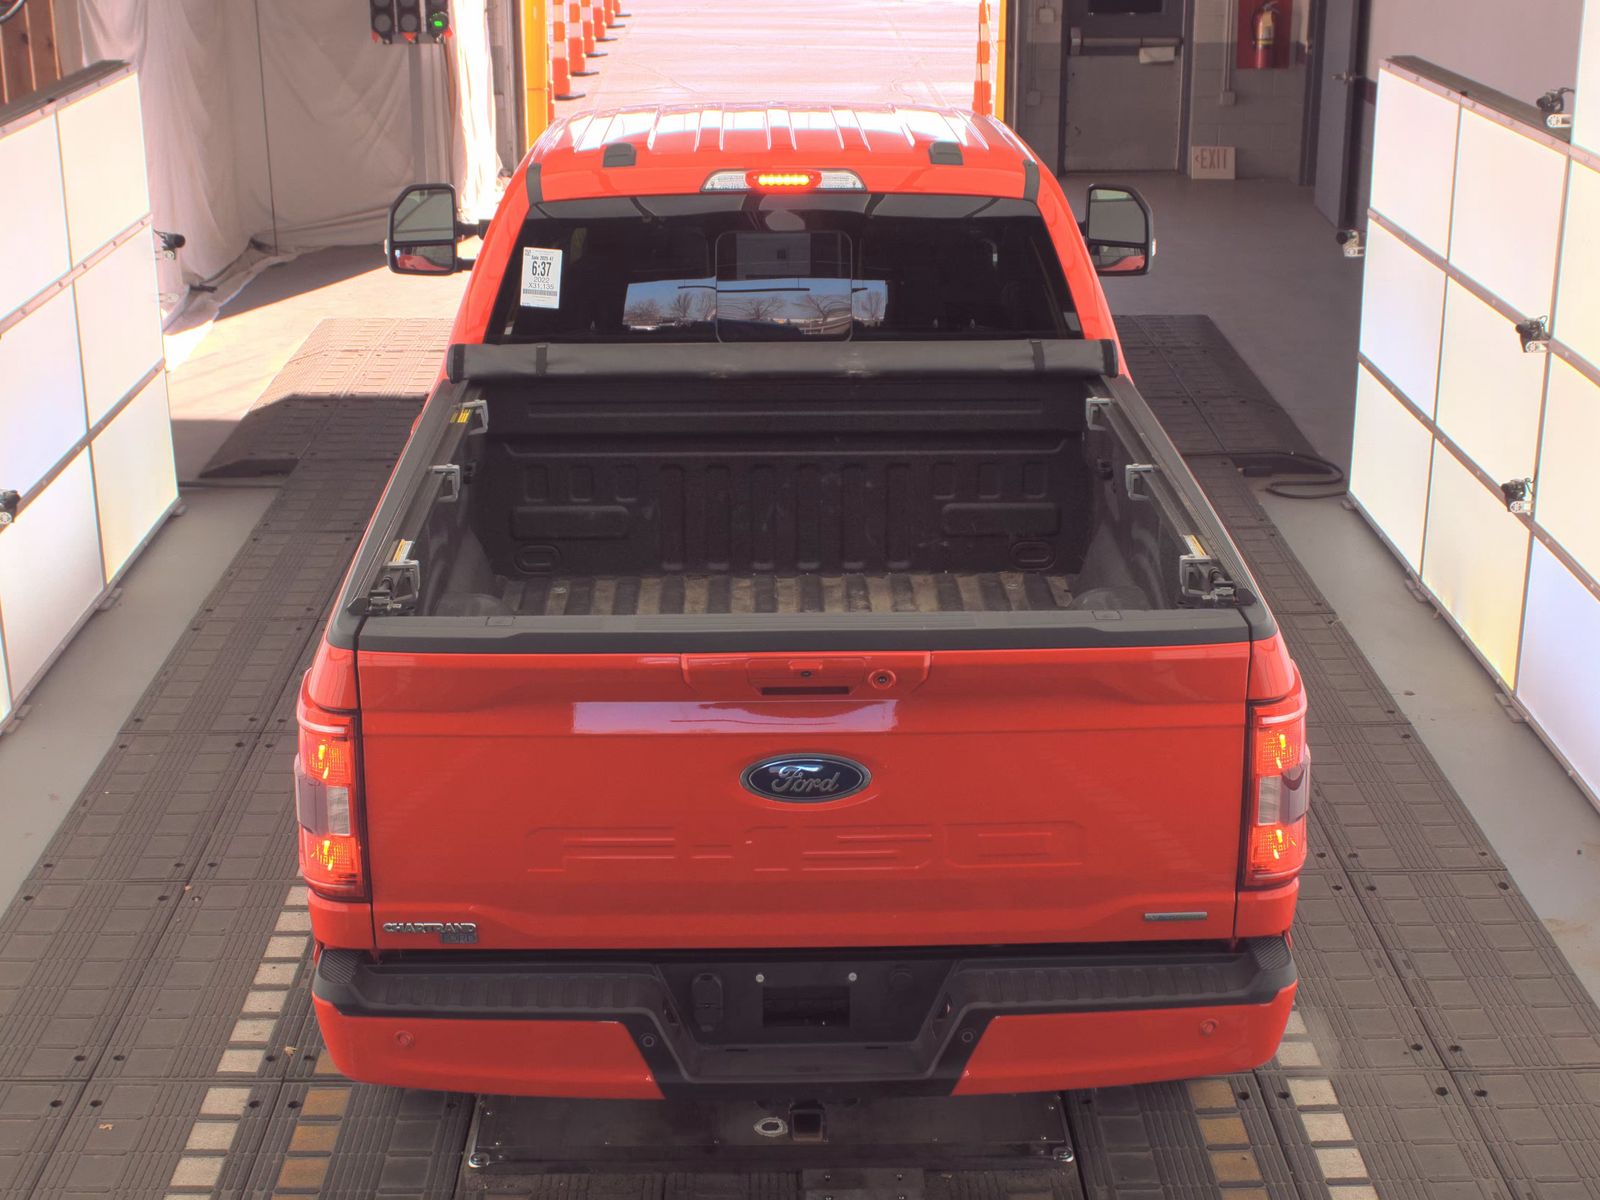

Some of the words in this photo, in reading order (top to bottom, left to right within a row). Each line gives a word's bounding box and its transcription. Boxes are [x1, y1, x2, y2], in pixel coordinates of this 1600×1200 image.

[1200, 148, 1228, 169] EXIT
[531, 261, 552, 277] 6:37
[770, 764, 841, 792] Ford
